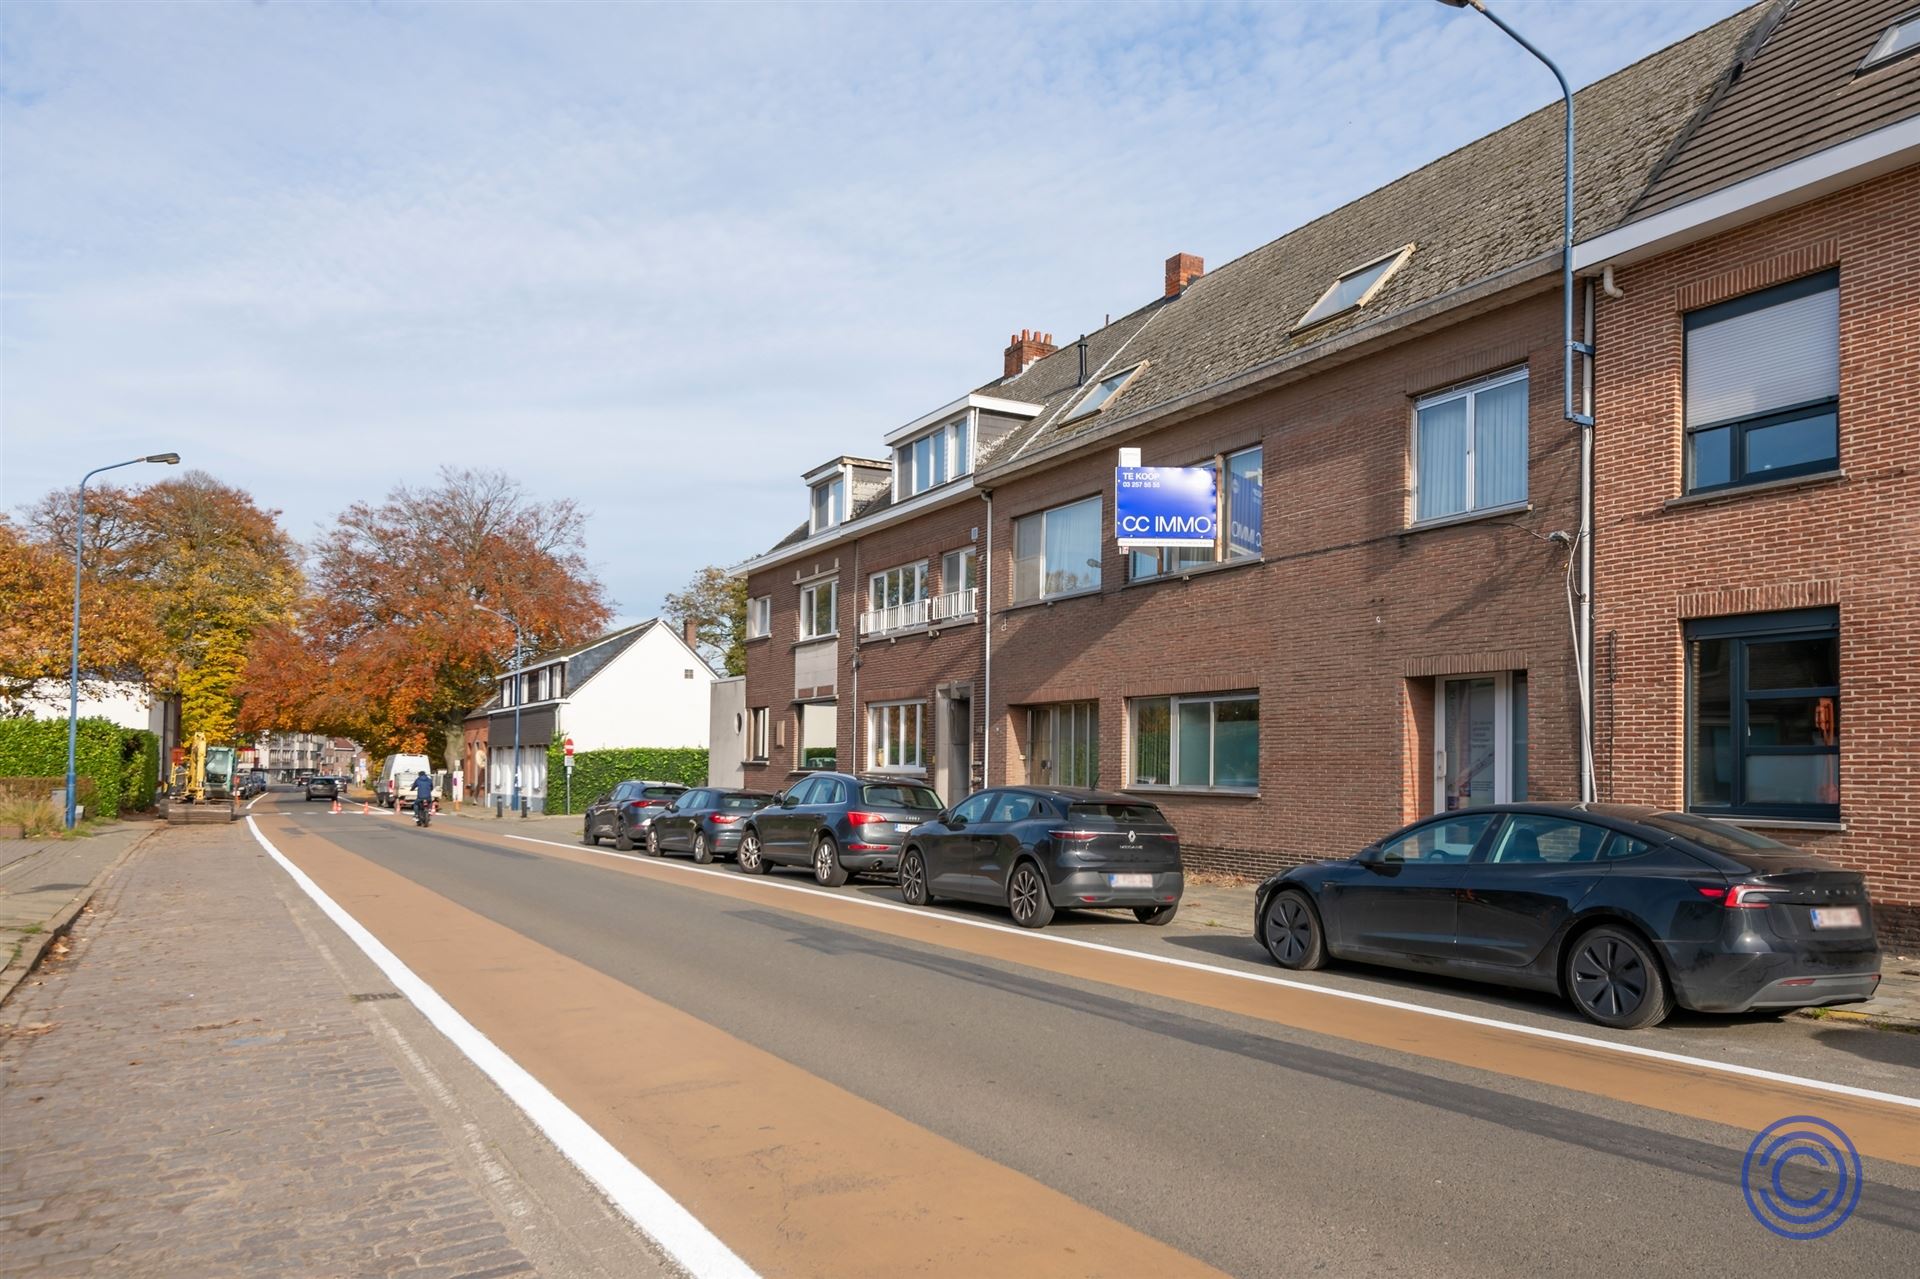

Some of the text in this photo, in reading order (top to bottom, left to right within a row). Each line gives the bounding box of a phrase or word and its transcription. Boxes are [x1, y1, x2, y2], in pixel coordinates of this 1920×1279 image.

[1123, 472, 1160, 480] TE KOOP
[1122, 516, 1211, 533] CC IMMO
